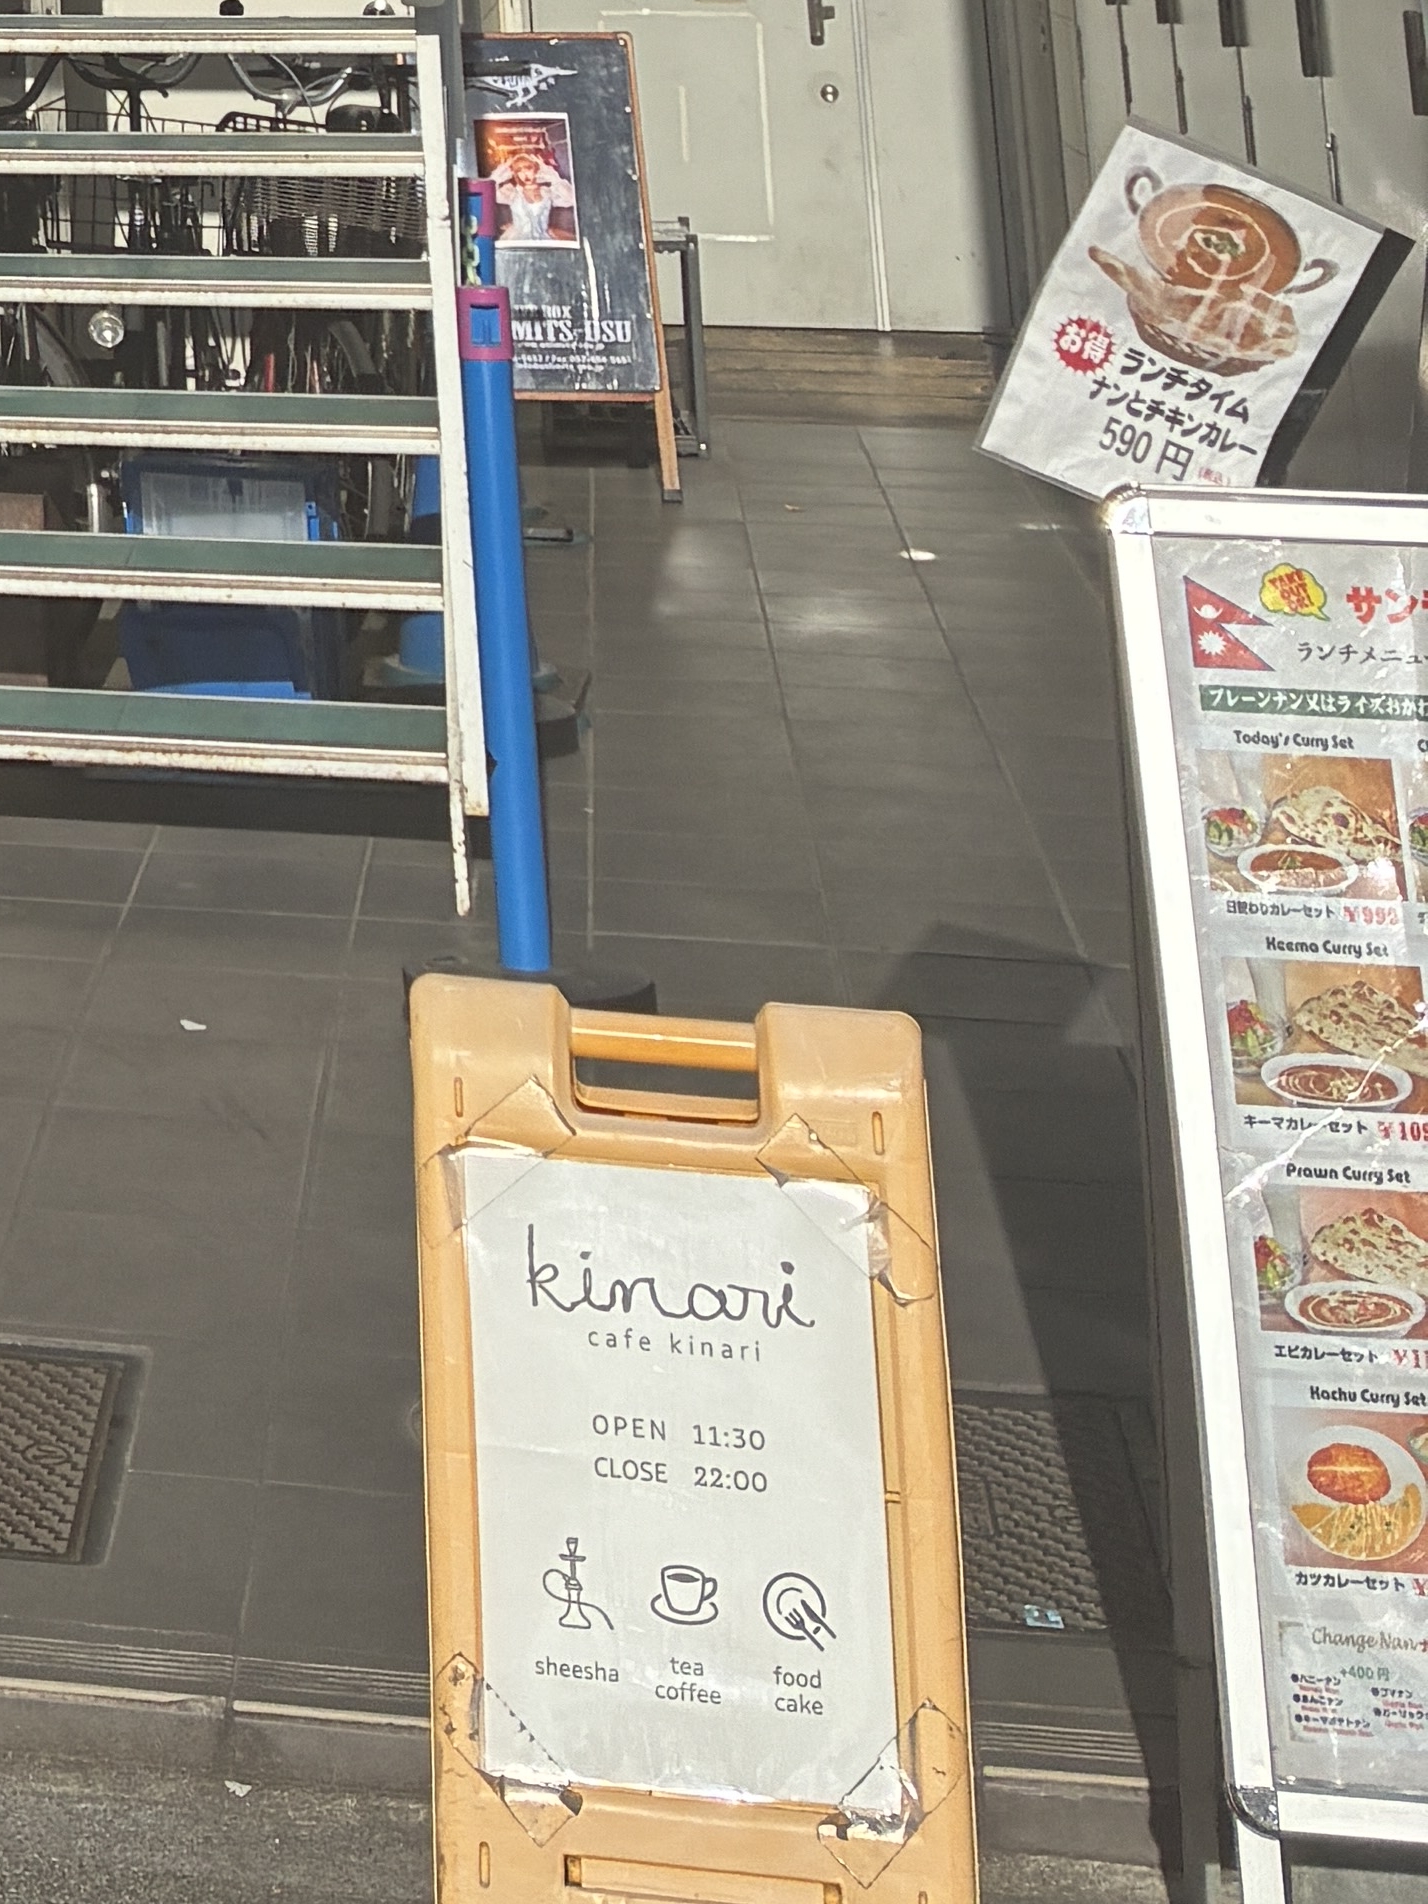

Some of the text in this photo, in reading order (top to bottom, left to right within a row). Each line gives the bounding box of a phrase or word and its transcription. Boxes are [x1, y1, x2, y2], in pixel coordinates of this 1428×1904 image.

[1059, 322, 1110, 364] お得
[1120, 346, 1250, 424] ランチタイム
[1088, 375, 1258, 455] ナンとチキンカレー
[1346, 585, 1428, 625] サン
[1297, 641, 1428, 666] ランチメニュ
[1233, 729, 1356, 752] Today's Curry Set
[1322, 939, 1363, 960] Curry
[1366, 941, 1390, 958] Set
[1286, 1162, 1412, 1185] Prawn Curry Set
[525, 1222, 816, 1331] kinari
[587, 1325, 764, 1363] cafe kinari
[1360, 1388, 1401, 1408] Curry
[1403, 1391, 1428, 1407] Set
[591, 1413, 767, 1452] OPEN 11:30
[593, 1455, 769, 1494] CLOSE 22:00
[1295, 1571, 1406, 1592] カツカレーセット
[534, 1655, 621, 1685] sheesha
[670, 1655, 705, 1678] tea
[771, 1664, 823, 1691] food
[654, 1678, 723, 1707] coffee
[774, 1691, 825, 1717] cake
